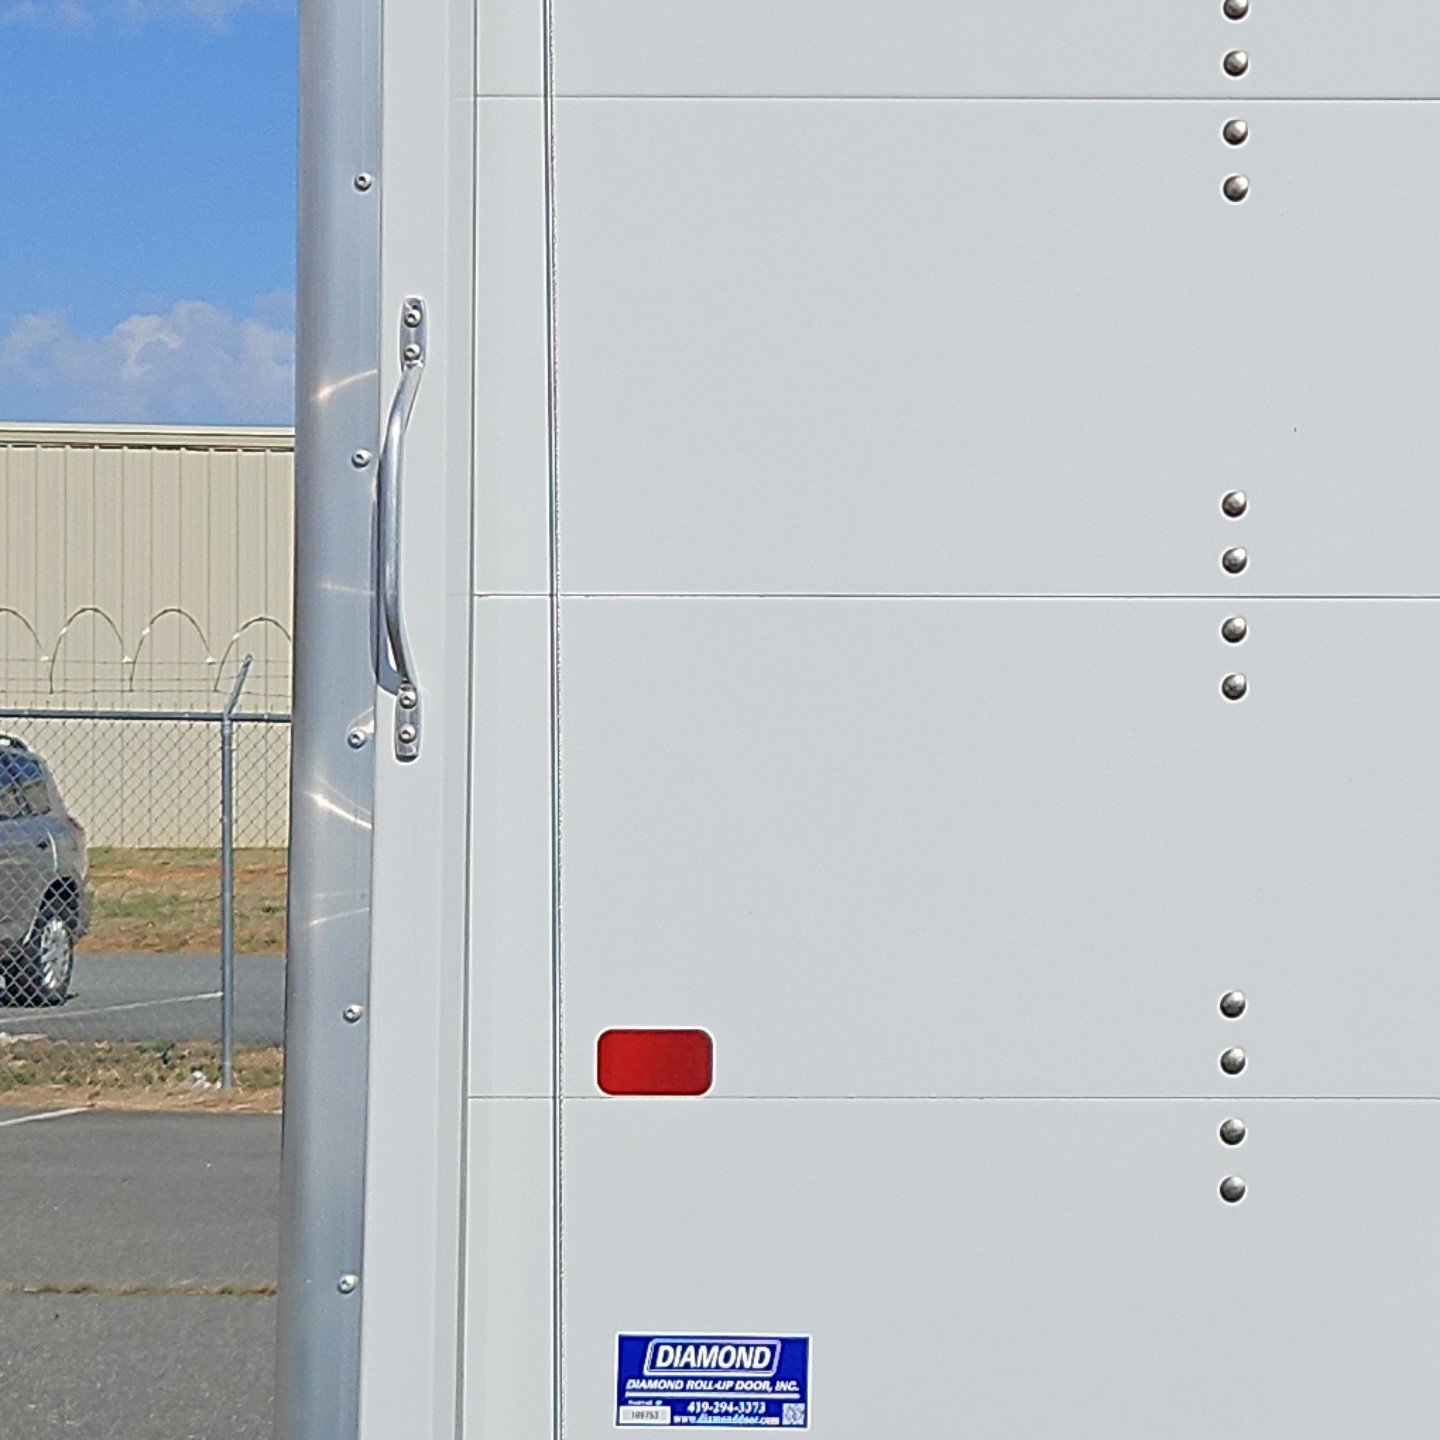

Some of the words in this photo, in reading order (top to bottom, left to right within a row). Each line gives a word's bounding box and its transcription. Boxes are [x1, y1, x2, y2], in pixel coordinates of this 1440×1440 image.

[655, 1345, 771, 1369] DIAMOND
[626, 1379, 684, 1390] DIAMOND
[686, 1379, 734, 1391] ROLL-UP
[735, 1380, 772, 1392] DOOR,
[775, 1381, 799, 1391] INC.
